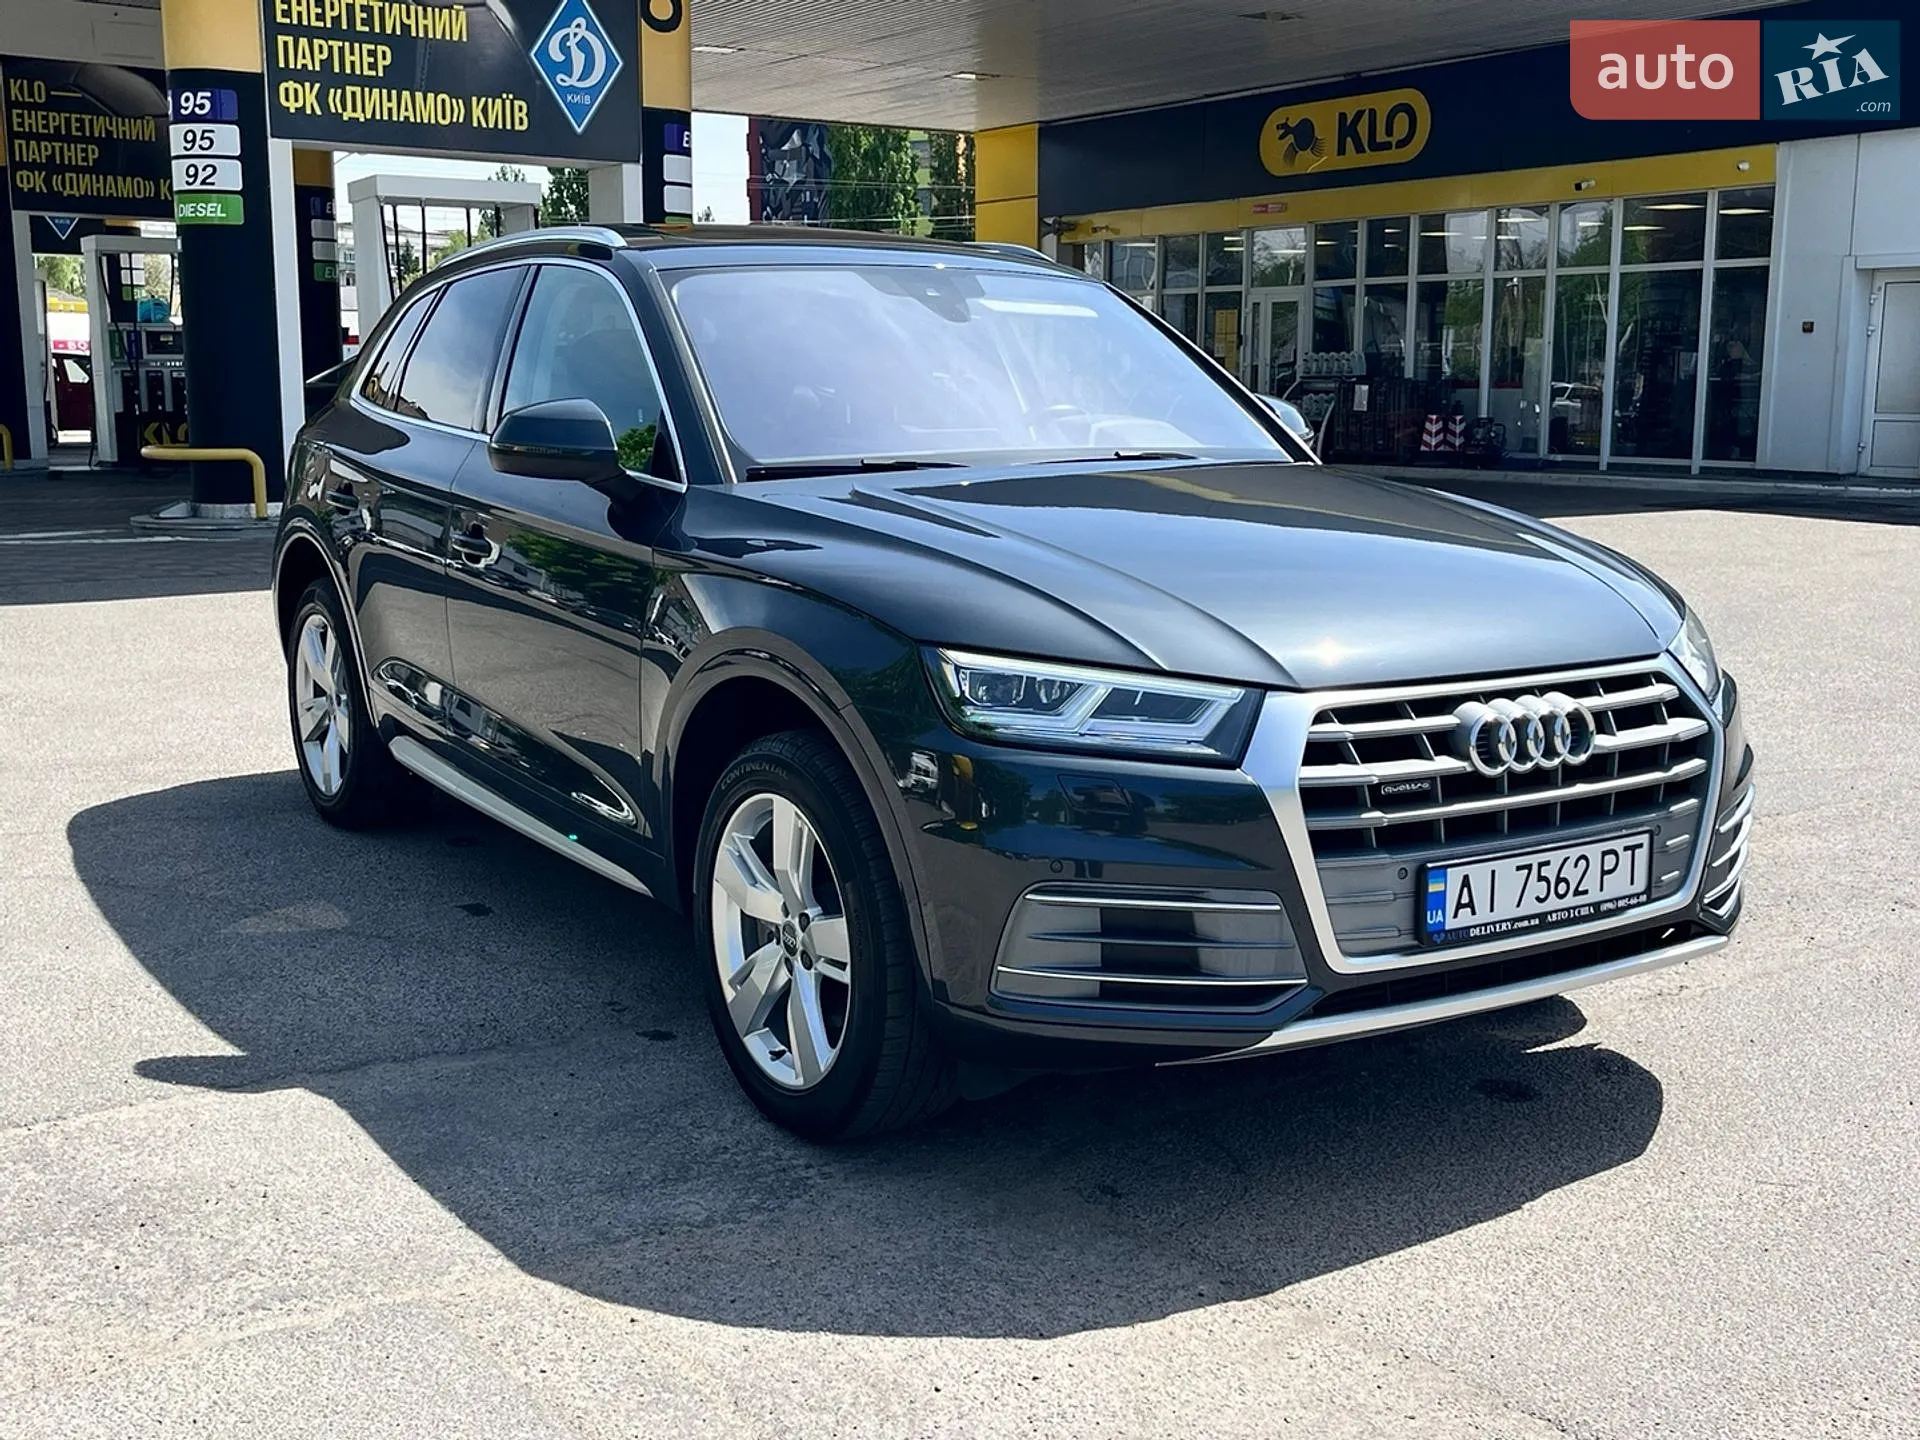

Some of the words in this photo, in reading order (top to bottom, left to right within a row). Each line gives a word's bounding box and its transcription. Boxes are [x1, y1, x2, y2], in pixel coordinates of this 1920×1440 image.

[275, 0, 468, 42] ЕНЕРГЕТИЧНИЙ
[277, 34, 392, 77] ПАРТНЕР
[9, 78, 47, 103] KLO
[180, 91, 212, 115] 95
[566, 93, 592, 104] КИЇВ
[279, 80, 322, 115] ФК
[328, 85, 466, 126] «ДИНАМО»
[471, 92, 529, 131] КИЇВ
[11, 109, 156, 142] ЕНЕРГЕТИЧНИЙ
[1337, 102, 1418, 156] KLO
[14, 139, 99, 167] ПАРТНЕР
[183, 129, 215, 151] 95
[16, 169, 48, 193] ФК
[52, 172, 155, 199] «ДИНАМО»
[185, 163, 217, 186] 92
[179, 202, 226, 217] DIESEL
[1452, 869, 1497, 919] AI
[1514, 854, 1590, 908] 7562
[1600, 842, 1644, 893] PT
[1427, 909, 1443, 924] UA
